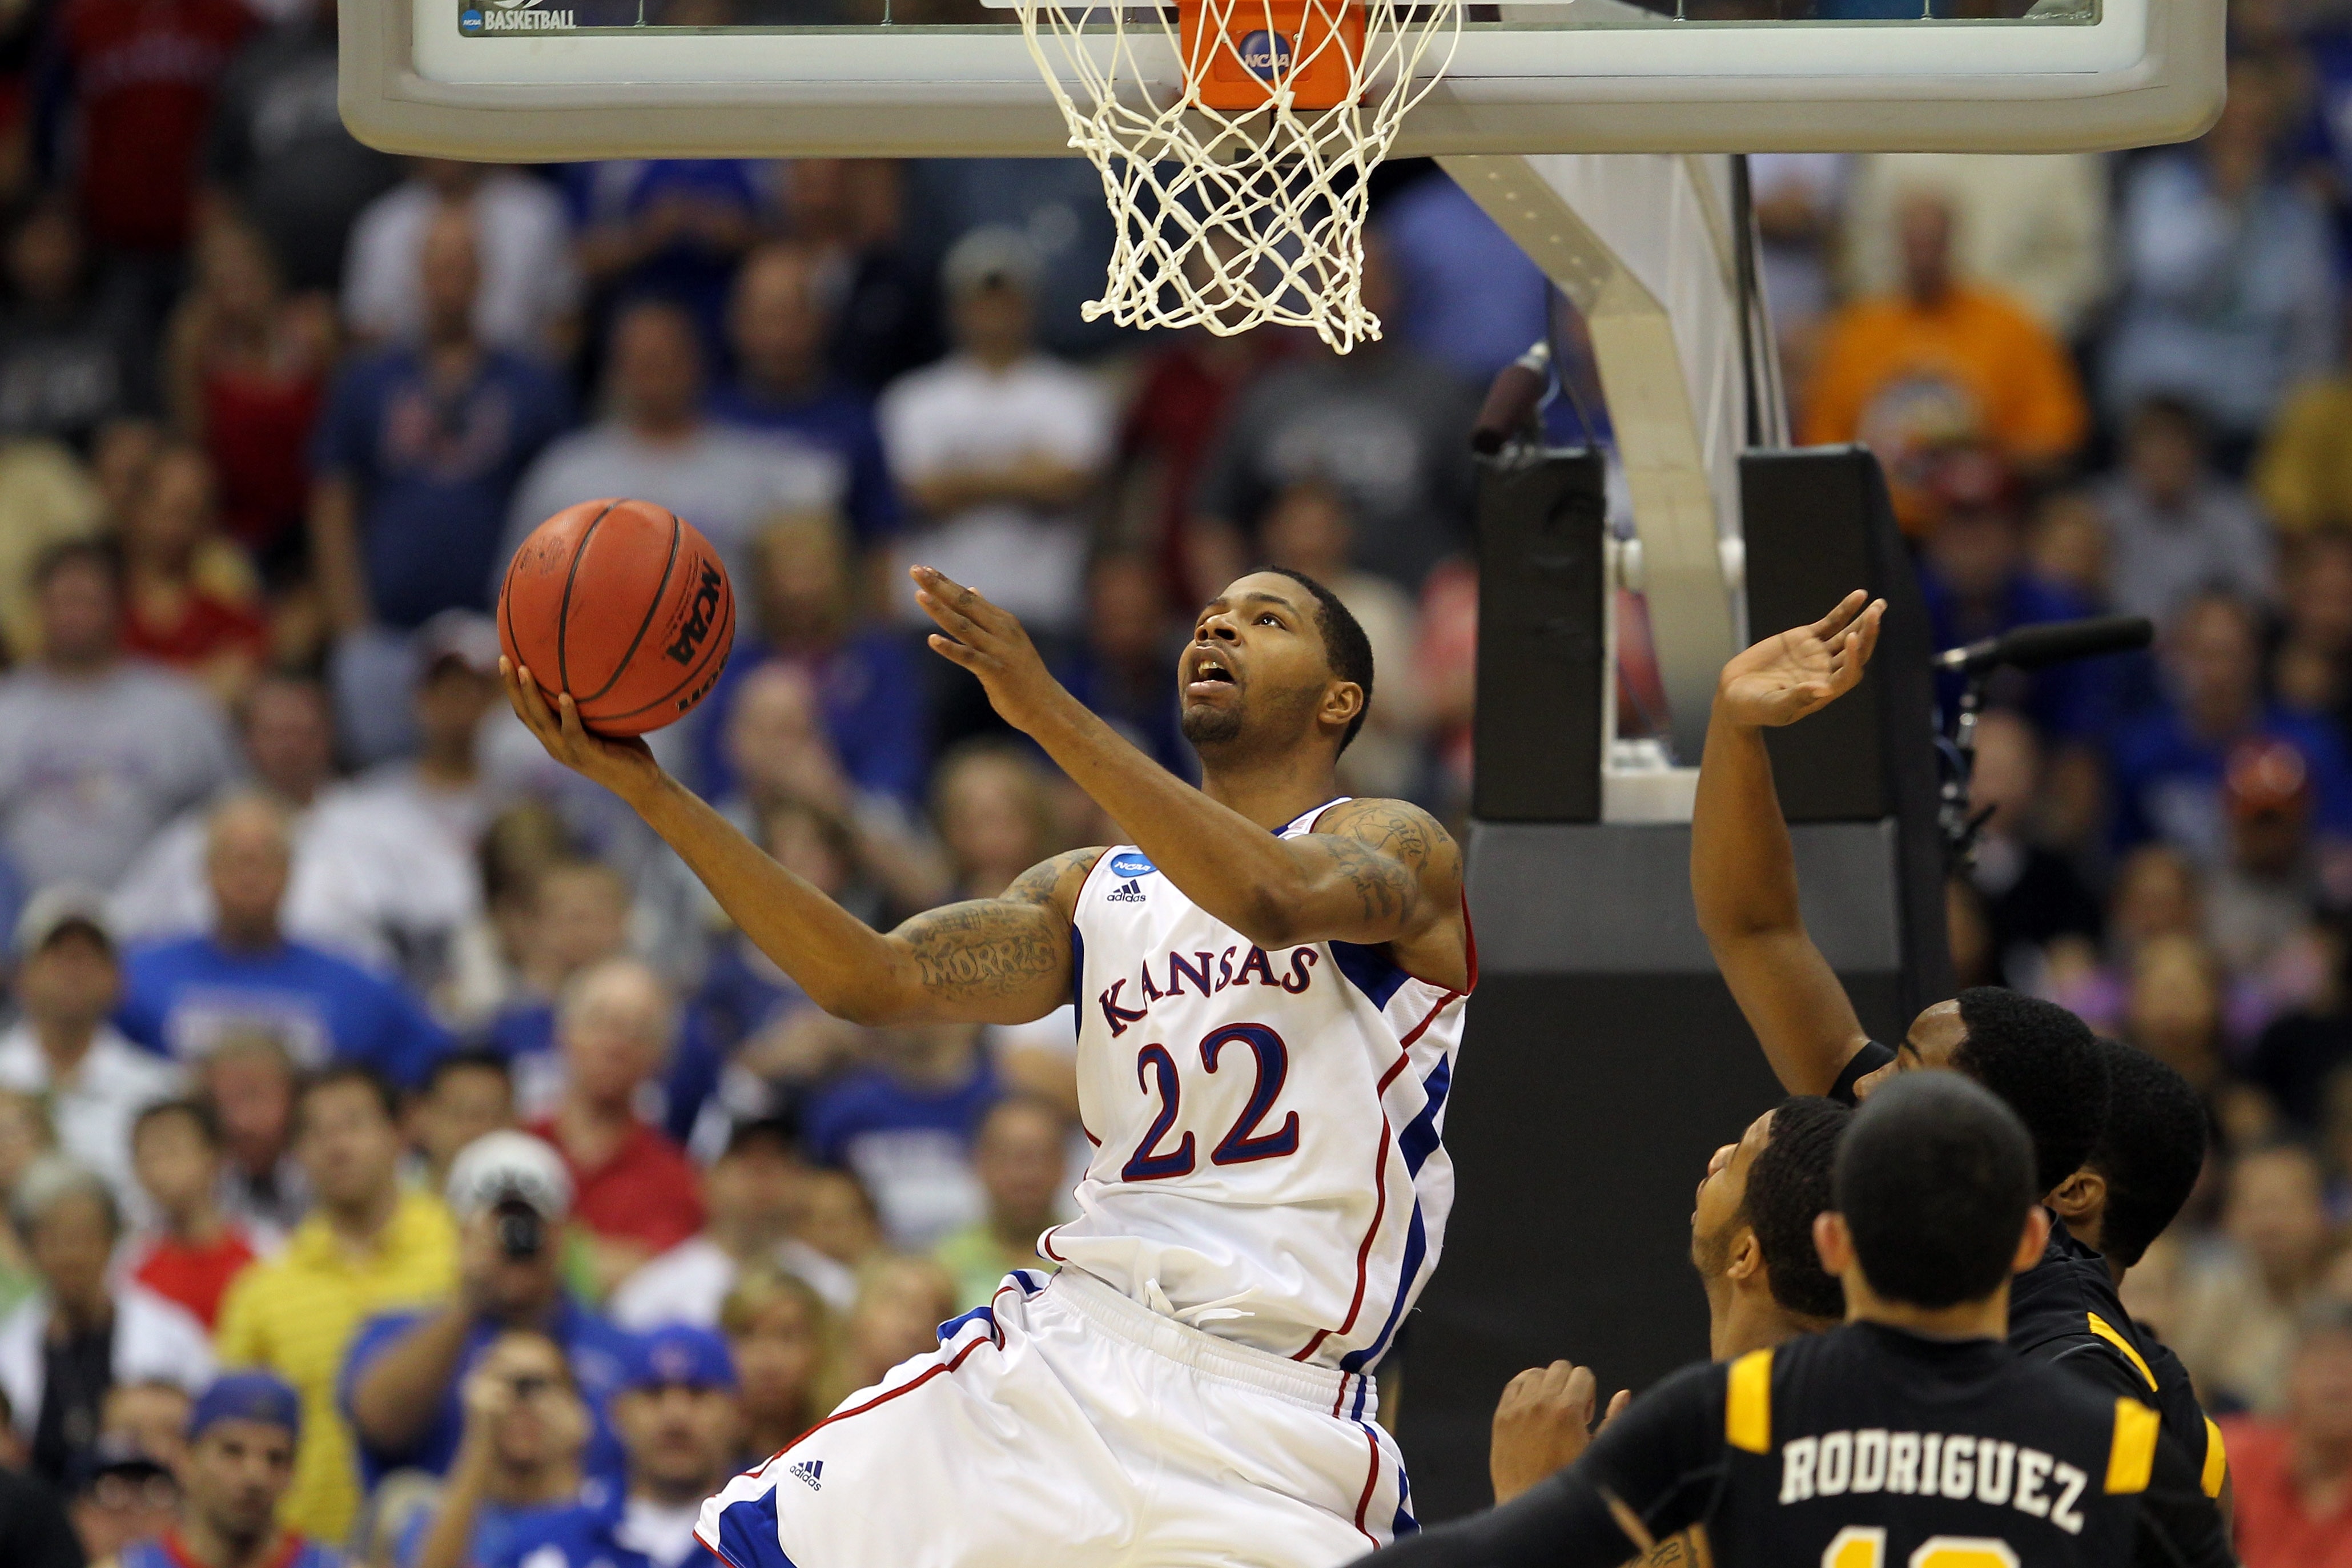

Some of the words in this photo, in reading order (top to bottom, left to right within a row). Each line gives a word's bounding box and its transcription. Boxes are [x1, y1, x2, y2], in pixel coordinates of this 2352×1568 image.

[485, 9, 577, 30] BASKETBALL
[667, 557, 722, 666] NCAA
[1114, 861, 1151, 872] NCAA
[1107, 891, 1147, 903] adidas
[1099, 944, 1319, 1038] KANSAS
[1121, 1022, 1300, 1182] 22
[789, 1465, 822, 1491] adidas
[1778, 1428, 2088, 1536] RODRIGUEZ
